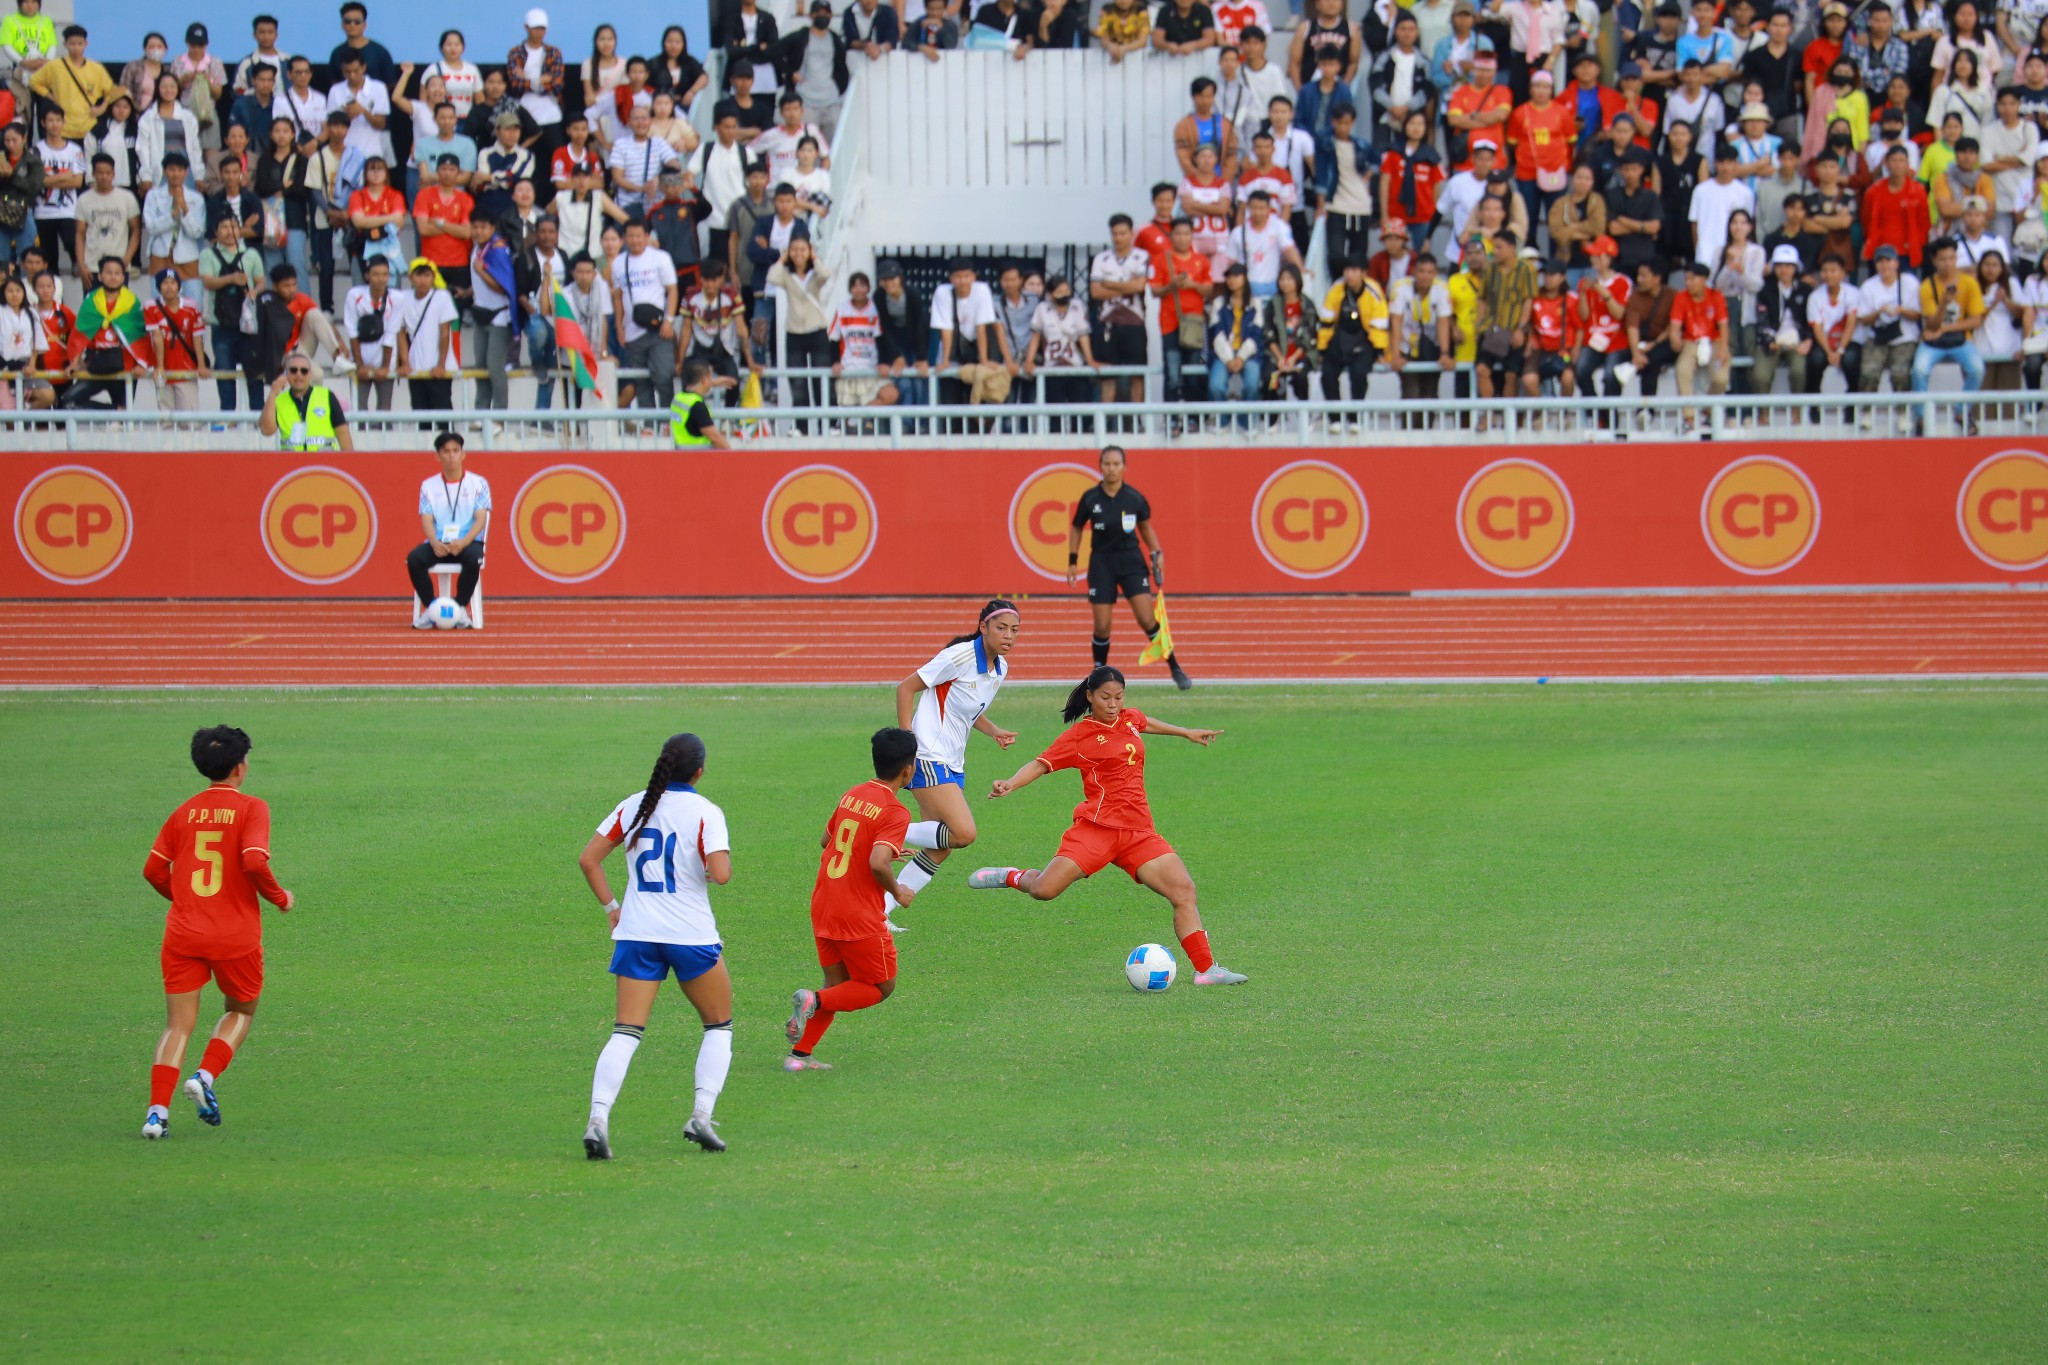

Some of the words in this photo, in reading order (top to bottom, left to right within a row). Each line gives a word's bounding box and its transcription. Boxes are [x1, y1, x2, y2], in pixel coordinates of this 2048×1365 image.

[35, 504, 113, 548] CP
[281, 504, 357, 548] CP
[531, 502, 607, 546] CP
[783, 502, 858, 545] CP
[1273, 498, 1348, 542] CP
[1477, 496, 1553, 540] CP
[1722, 493, 1799, 538] CP
[1978, 488, 2048, 533] CP
[1124, 742, 1137, 766] 2
[187, 808, 237, 825] P.P.WIN
[190, 830, 224, 897] 5
[635, 827, 678, 894] 21
[826, 818, 860, 880] 9
